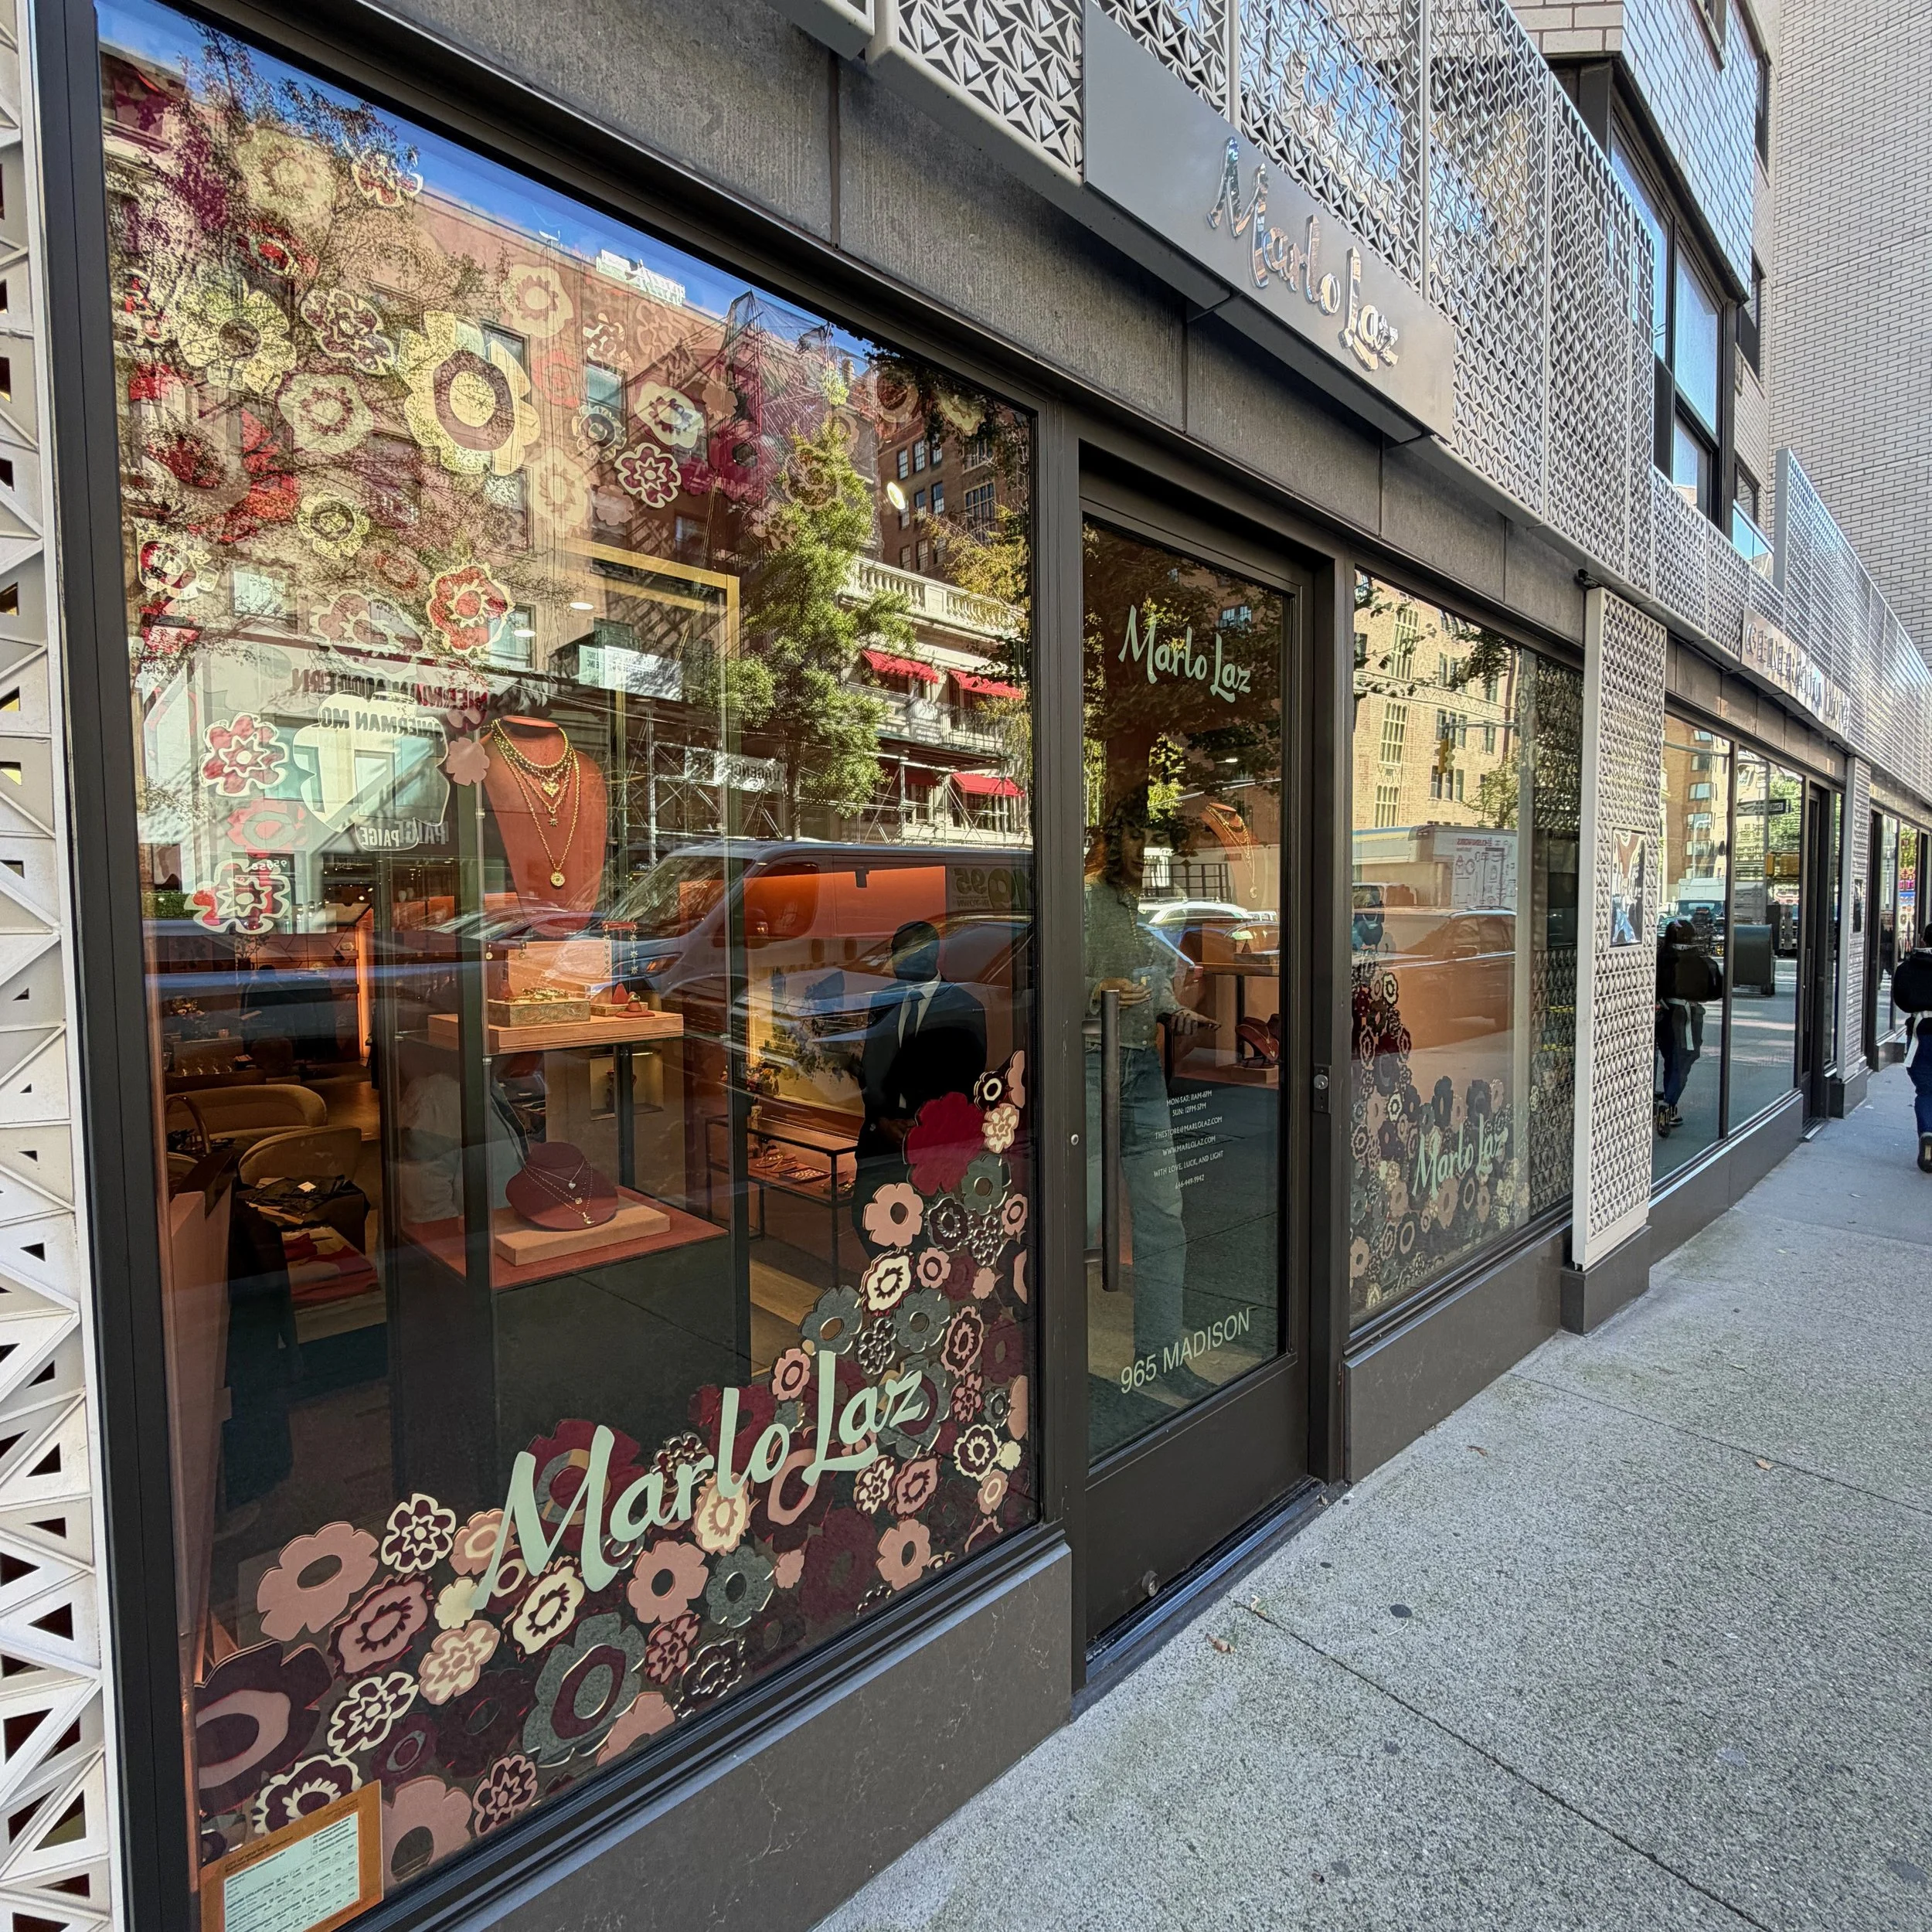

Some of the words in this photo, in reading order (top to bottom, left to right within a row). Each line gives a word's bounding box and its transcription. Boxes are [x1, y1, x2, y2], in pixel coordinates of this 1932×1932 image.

[1207, 136, 1341, 316] Marlo
[1338, 246, 1400, 372] Laz
[1117, 604, 1207, 685] Marlo
[1209, 632, 1251, 703] Laz
[1155, 1116, 1223, 1140] THESTORE@MARLOLAZ.COM
[1162, 1135, 1216, 1156] WWW.MARLOLAZ.COM
[1172, 1108, 1185, 1117] SUN:
[1153, 1167, 1168, 1178] WITH
[1198, 1155, 1209, 1165] AND
[1209, 1150, 1224, 1161] LIGHT
[1411, 1121, 1475, 1201] Marlo
[1475, 1113, 1509, 1176] Laz
[1120, 1353, 1158, 1395] 965
[1163, 1307, 1250, 1373] MADISON
[470, 1387, 791, 1611] Marlo
[801, 1350, 923, 1487] Laz
